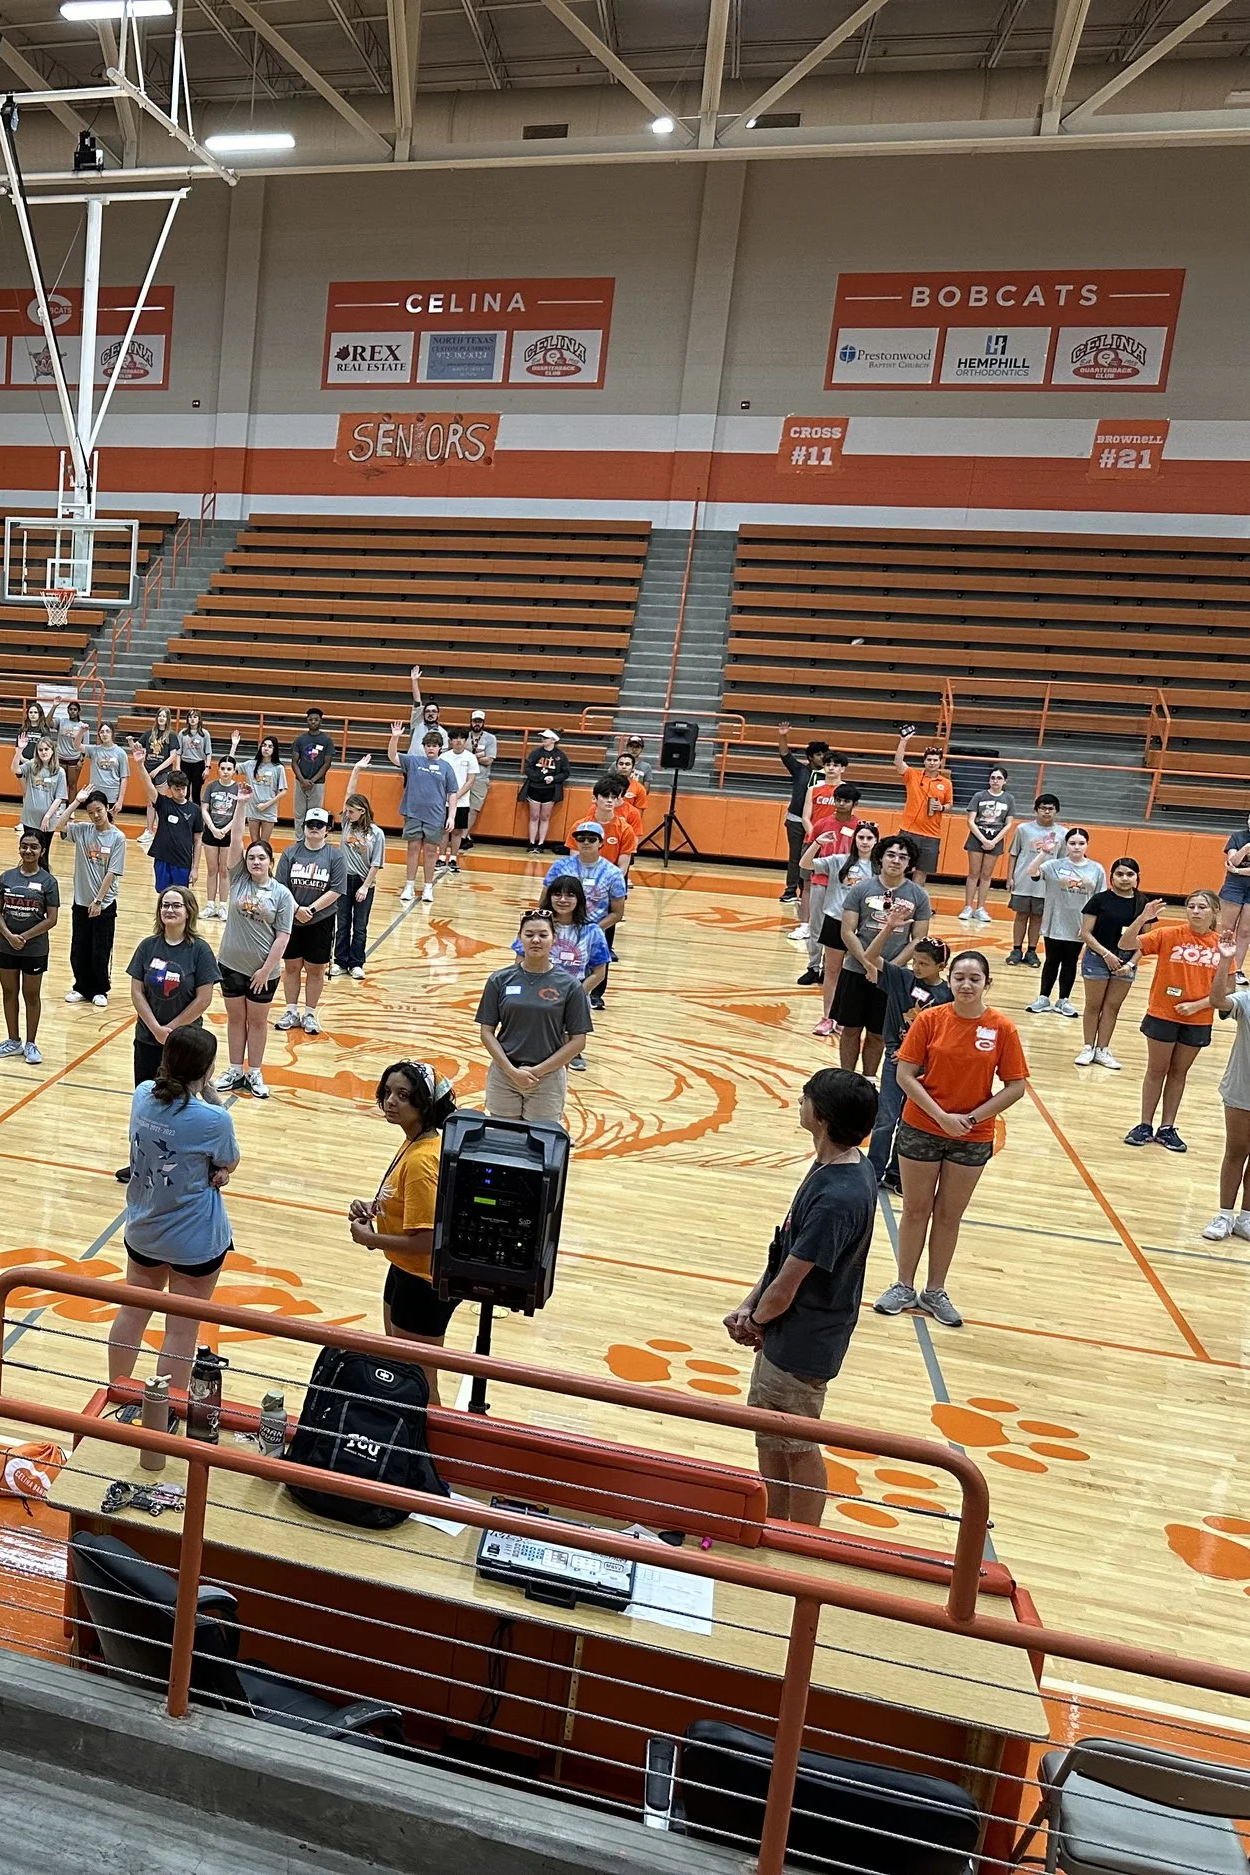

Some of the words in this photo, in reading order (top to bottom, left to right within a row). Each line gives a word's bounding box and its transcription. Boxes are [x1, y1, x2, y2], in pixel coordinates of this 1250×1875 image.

[405, 291, 526, 314] CELINA
[911, 284, 1098, 308] BOBCATS
[465, 336, 496, 344] TEXAS
[524, 335, 587, 364] CELINA
[101, 341, 154, 368] CEINA
[351, 344, 401, 361] REX
[857, 348, 932, 361] Prestonwood
[1071, 334, 1147, 366] CELINA
[336, 362, 364, 372] REAL
[367, 362, 407, 372] ESTATE
[955, 369, 1030, 377] ORTHODONTICS
[957, 358, 1030, 369] HEMPHILL
[790, 426, 843, 439] CROSS
[348, 422, 491, 463] SENIORS
[791, 446, 833, 466] #11
[1099, 448, 1152, 469] #21
[260, 1430, 282, 1443] OUGH
[14, 1470, 34, 1489] CELINA
